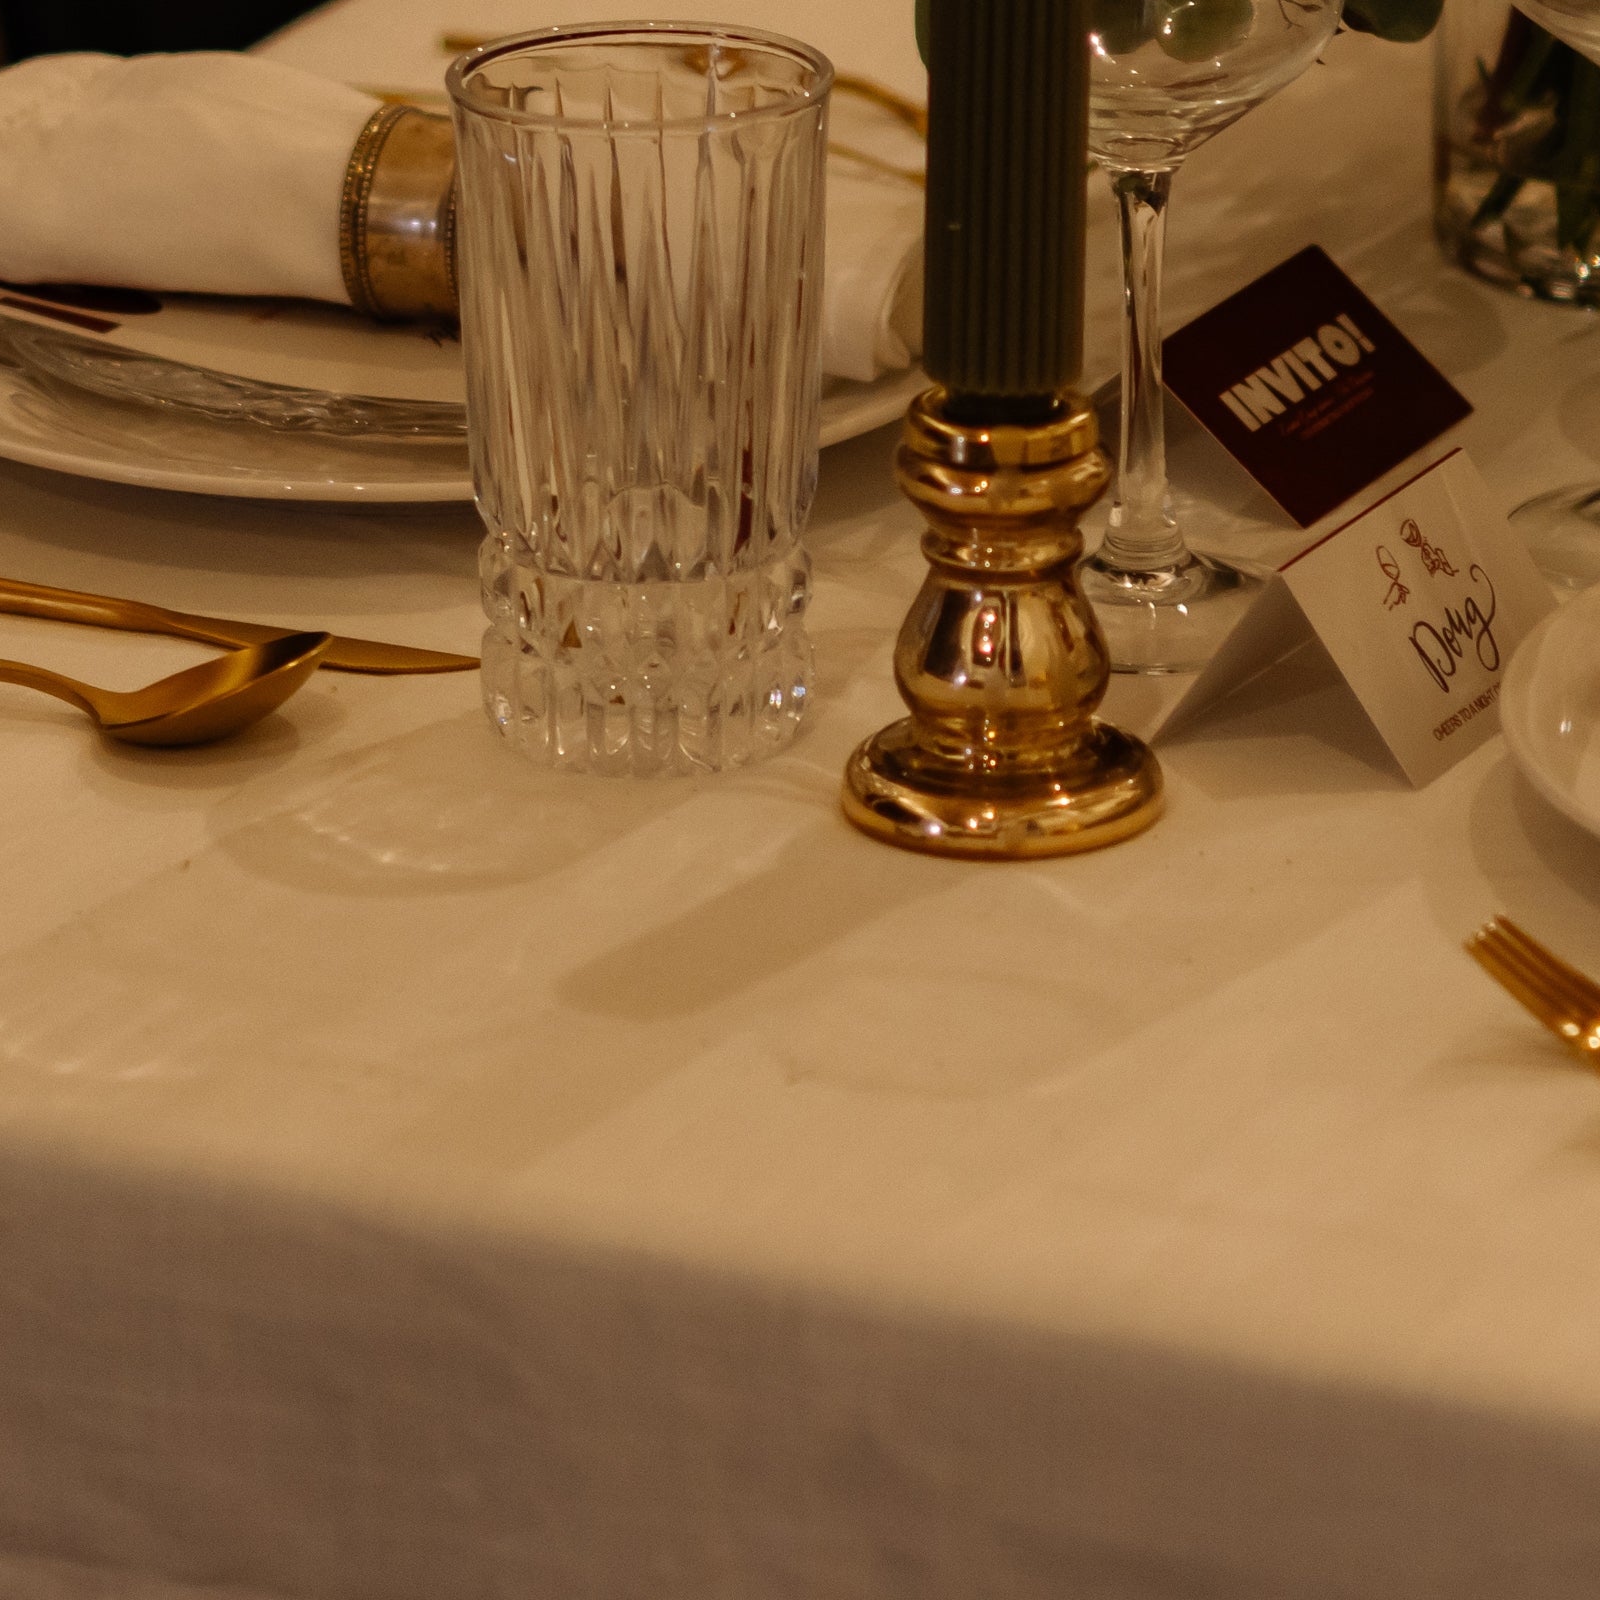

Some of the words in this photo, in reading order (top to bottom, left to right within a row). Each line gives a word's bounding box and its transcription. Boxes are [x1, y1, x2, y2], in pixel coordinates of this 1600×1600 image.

[1219, 313, 1376, 432] INVITO!
[1432, 714, 1463, 741] CHEERS
[1457, 707, 1473, 722] TO
[1469, 703, 1479, 717] A
